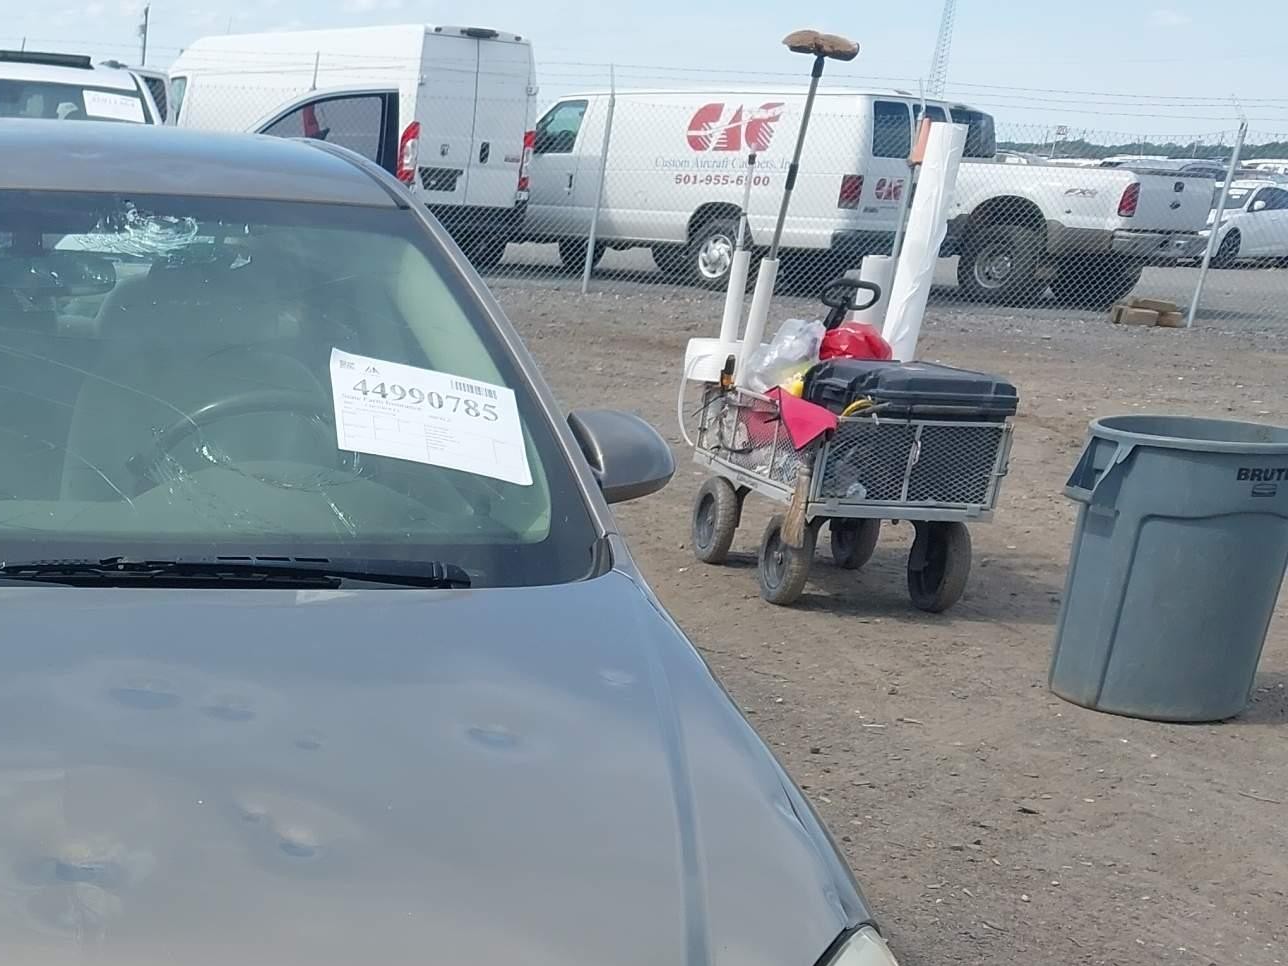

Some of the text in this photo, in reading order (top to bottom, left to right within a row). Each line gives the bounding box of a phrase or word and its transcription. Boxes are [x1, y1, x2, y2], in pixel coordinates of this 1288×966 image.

[655, 157, 690, 168] Custom
[696, 157, 729, 168] Aircraft
[353, 379, 498, 421] 44990785
